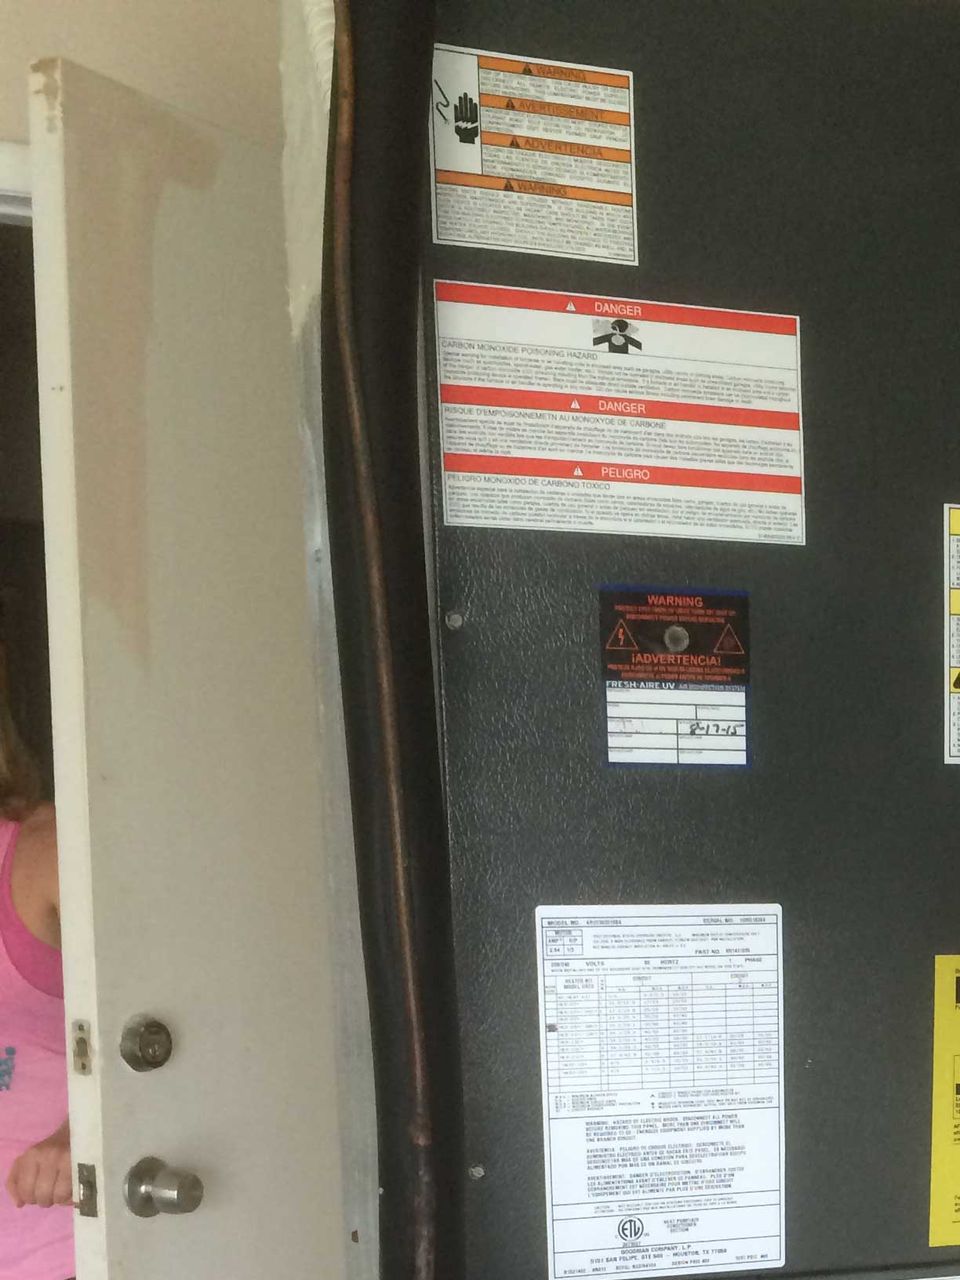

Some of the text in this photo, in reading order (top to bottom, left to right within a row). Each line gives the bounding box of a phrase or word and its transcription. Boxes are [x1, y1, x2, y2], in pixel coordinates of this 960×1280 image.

[594, 301, 642, 316] DANGER
[441, 341, 599, 361] CARBON MONOXIDE POISONING HAZARD
[598, 401, 646, 415] DANGER
[447, 474, 482, 484] PELIGRO
[601, 466, 650, 480] PELIGRO
[647, 594, 703, 607] WARNING
[662, 682, 676, 690] UV
